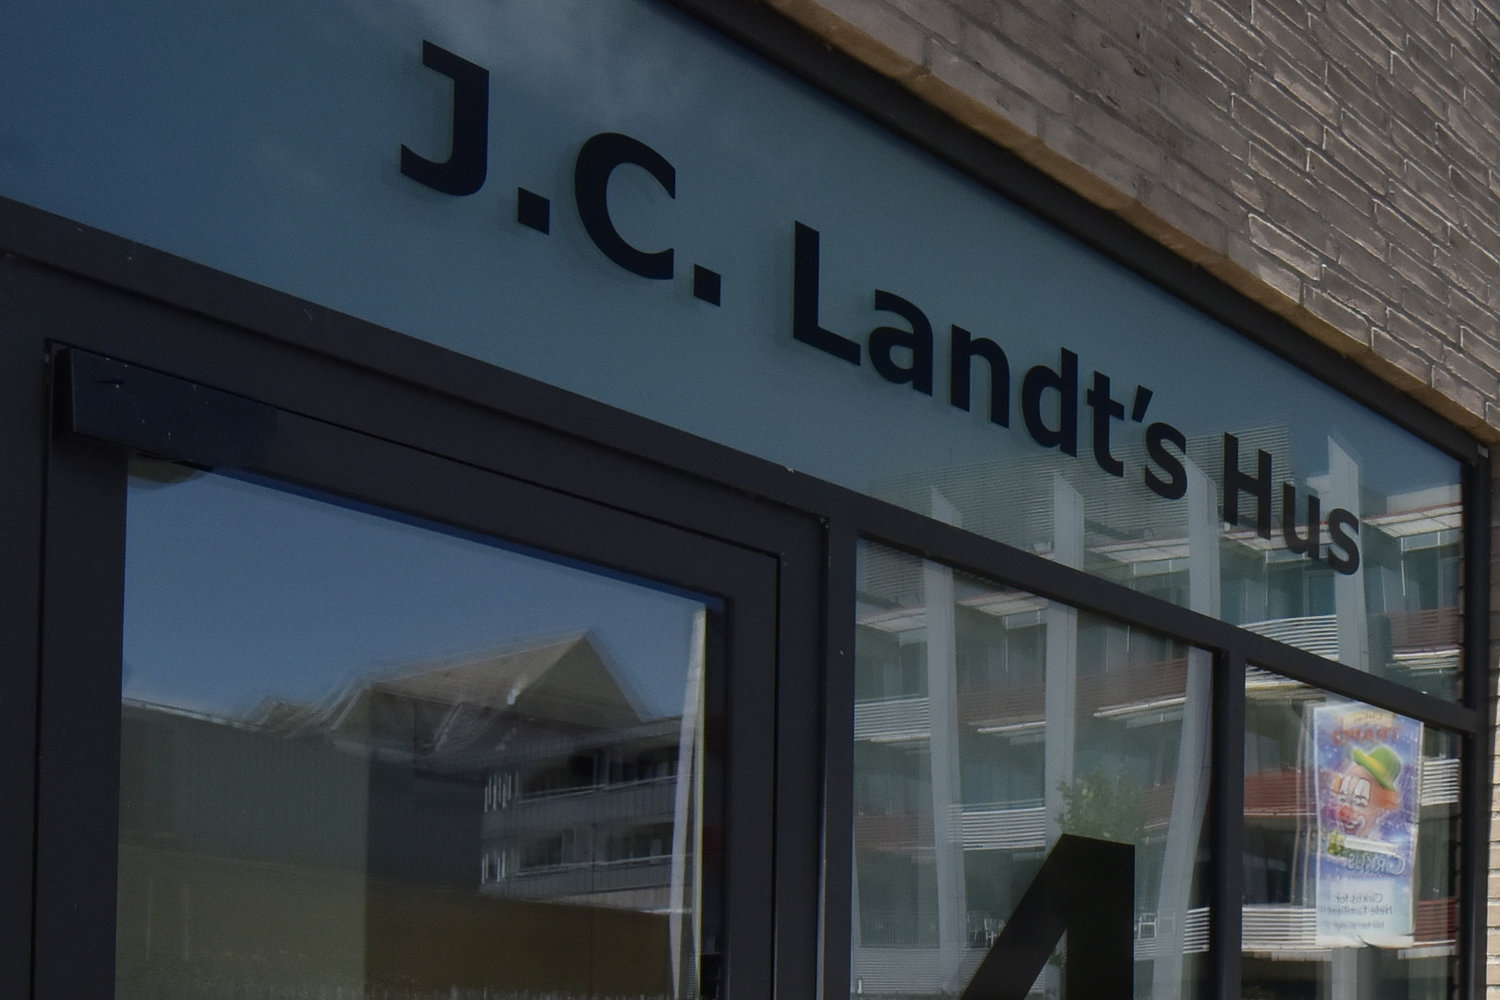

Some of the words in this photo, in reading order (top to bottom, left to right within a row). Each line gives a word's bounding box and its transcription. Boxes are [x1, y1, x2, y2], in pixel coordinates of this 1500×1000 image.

[400, 39, 721, 306] J.C.
[792, 221, 1188, 500] Landt's
[1222, 432, 1361, 575] Hus
